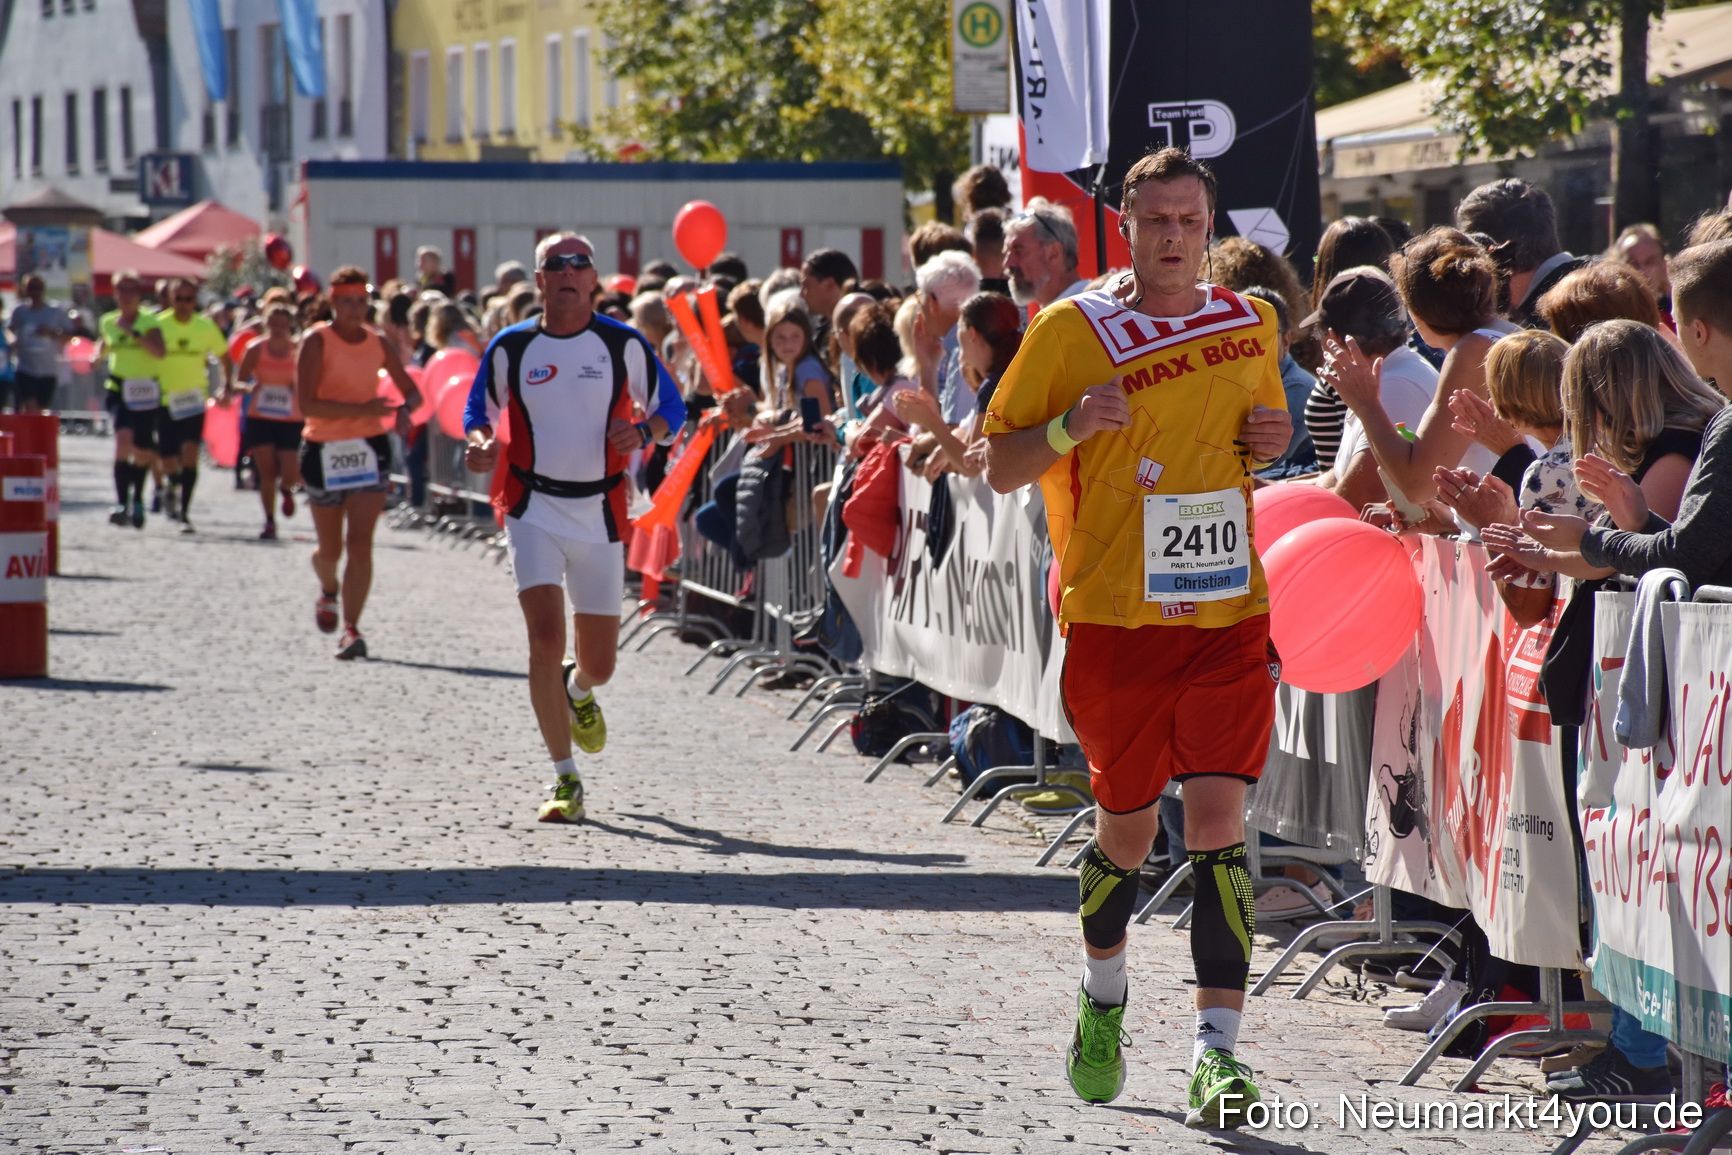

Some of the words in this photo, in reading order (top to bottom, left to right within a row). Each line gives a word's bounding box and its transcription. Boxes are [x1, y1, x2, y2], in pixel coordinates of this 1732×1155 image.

[1155, 110, 1181, 119] Team
[529, 368, 549, 379] tkn
[1122, 353, 1197, 395] MAX
[1201, 336, 1266, 367] BÖGL
[331, 451, 368, 470] 2097
[1178, 500, 1225, 516] BOCK
[1162, 520, 1237, 557] 2410
[1196, 559, 1226, 568] Neumarkt
[1174, 574, 1231, 590] Christian
[1188, 854, 1207, 863] ep
